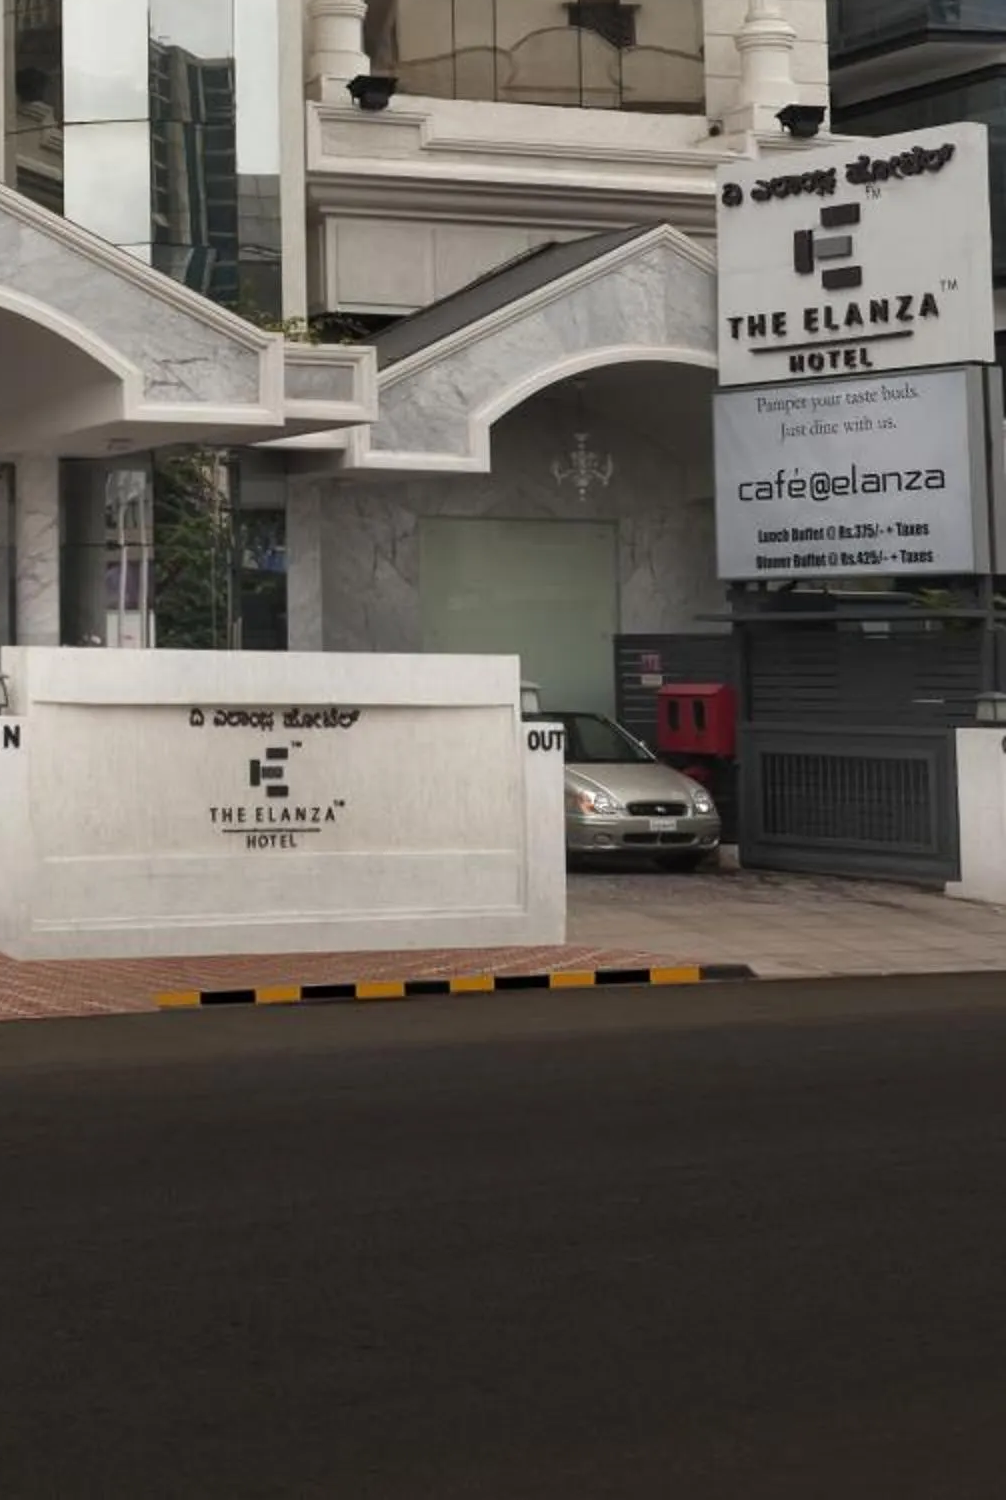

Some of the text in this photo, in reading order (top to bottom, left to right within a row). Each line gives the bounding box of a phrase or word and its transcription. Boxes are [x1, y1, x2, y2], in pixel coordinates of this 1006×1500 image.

[727, 311, 787, 340] THE
[803, 292, 939, 334] ELANZA
[789, 348, 873, 373] HOTEL
[757, 396, 807, 415] Pamper
[811, 394, 842, 413] your
[845, 389, 878, 405] taste
[781, 422, 807, 444] Just
[809, 419, 838, 435] dine
[844, 416, 873, 434] with
[738, 463, 946, 501] café@elanza
[896, 522, 930, 536] Taxes
[900, 550, 933, 564] Taxes
[528, 730, 565, 752] OUT
[210, 807, 335, 822] THE ELANZA
[246, 834, 297, 848] HOTEL
